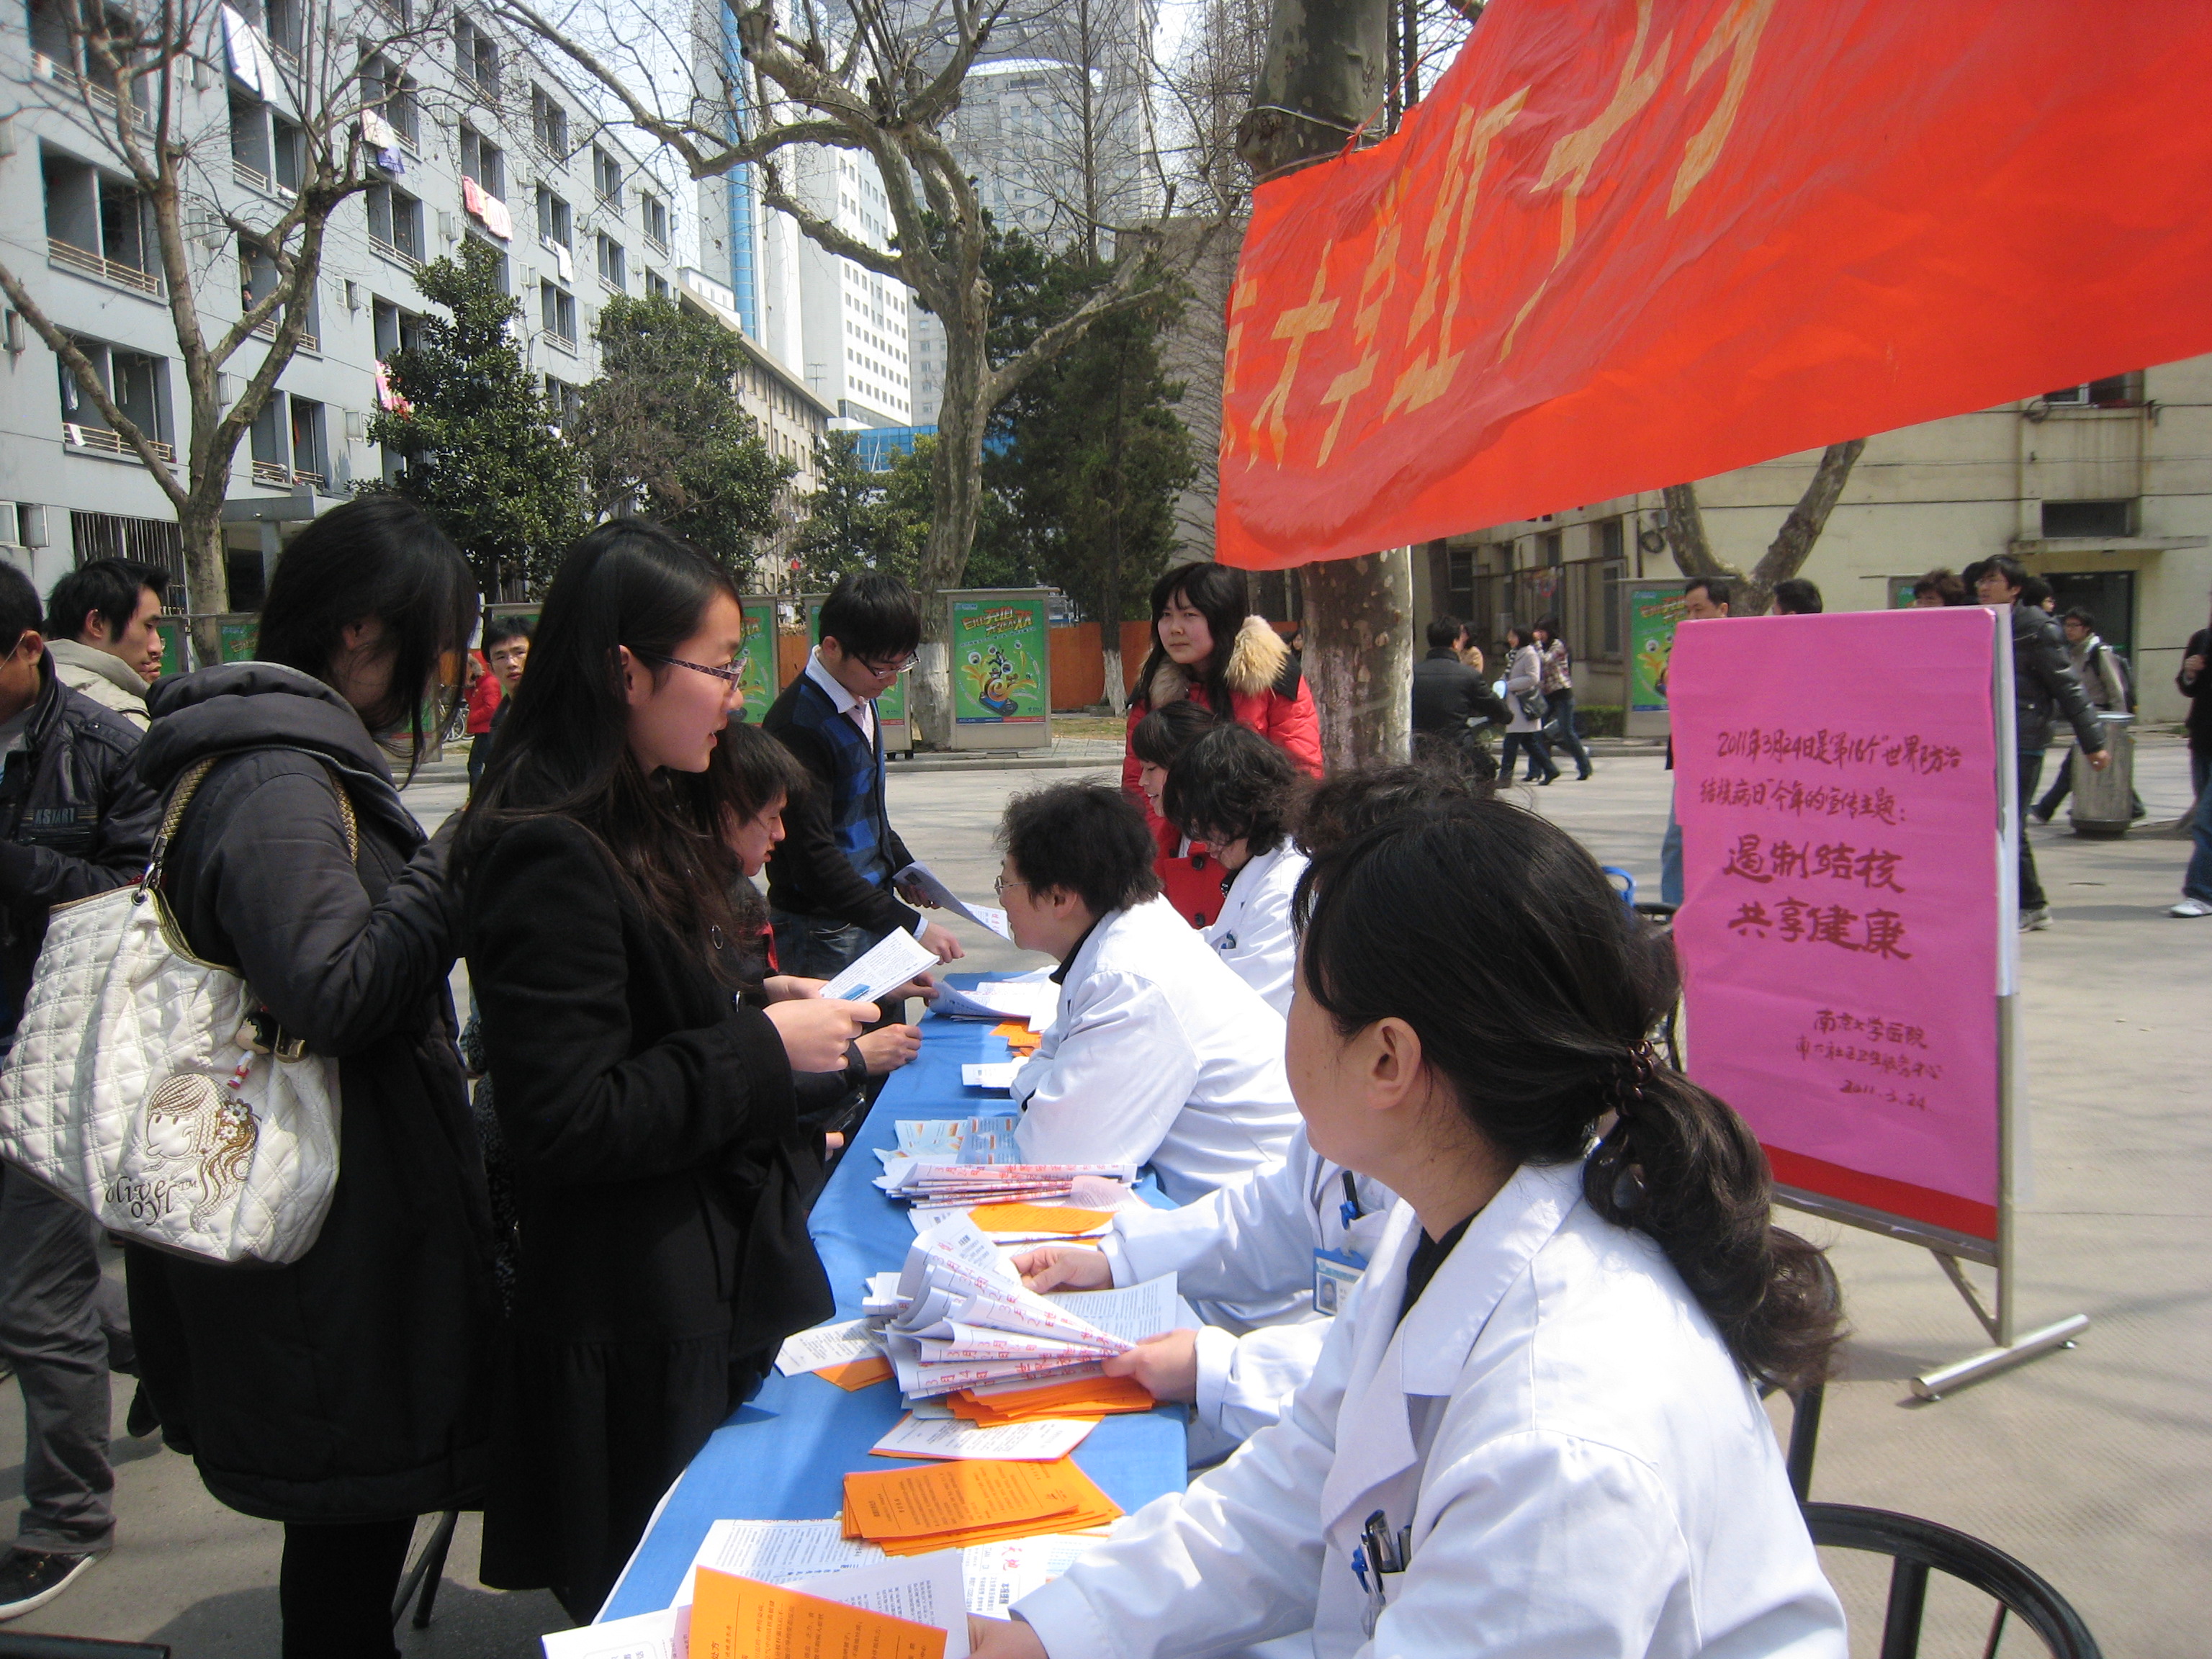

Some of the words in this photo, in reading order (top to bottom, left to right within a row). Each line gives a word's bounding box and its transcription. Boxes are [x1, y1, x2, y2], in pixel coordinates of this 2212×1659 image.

[1722, 834, 1907, 894] 遏制结核
[1728, 896, 1912, 961] 共享健康
[106, 1176, 167, 1203] olive
[131, 1184, 177, 1226] oyl
